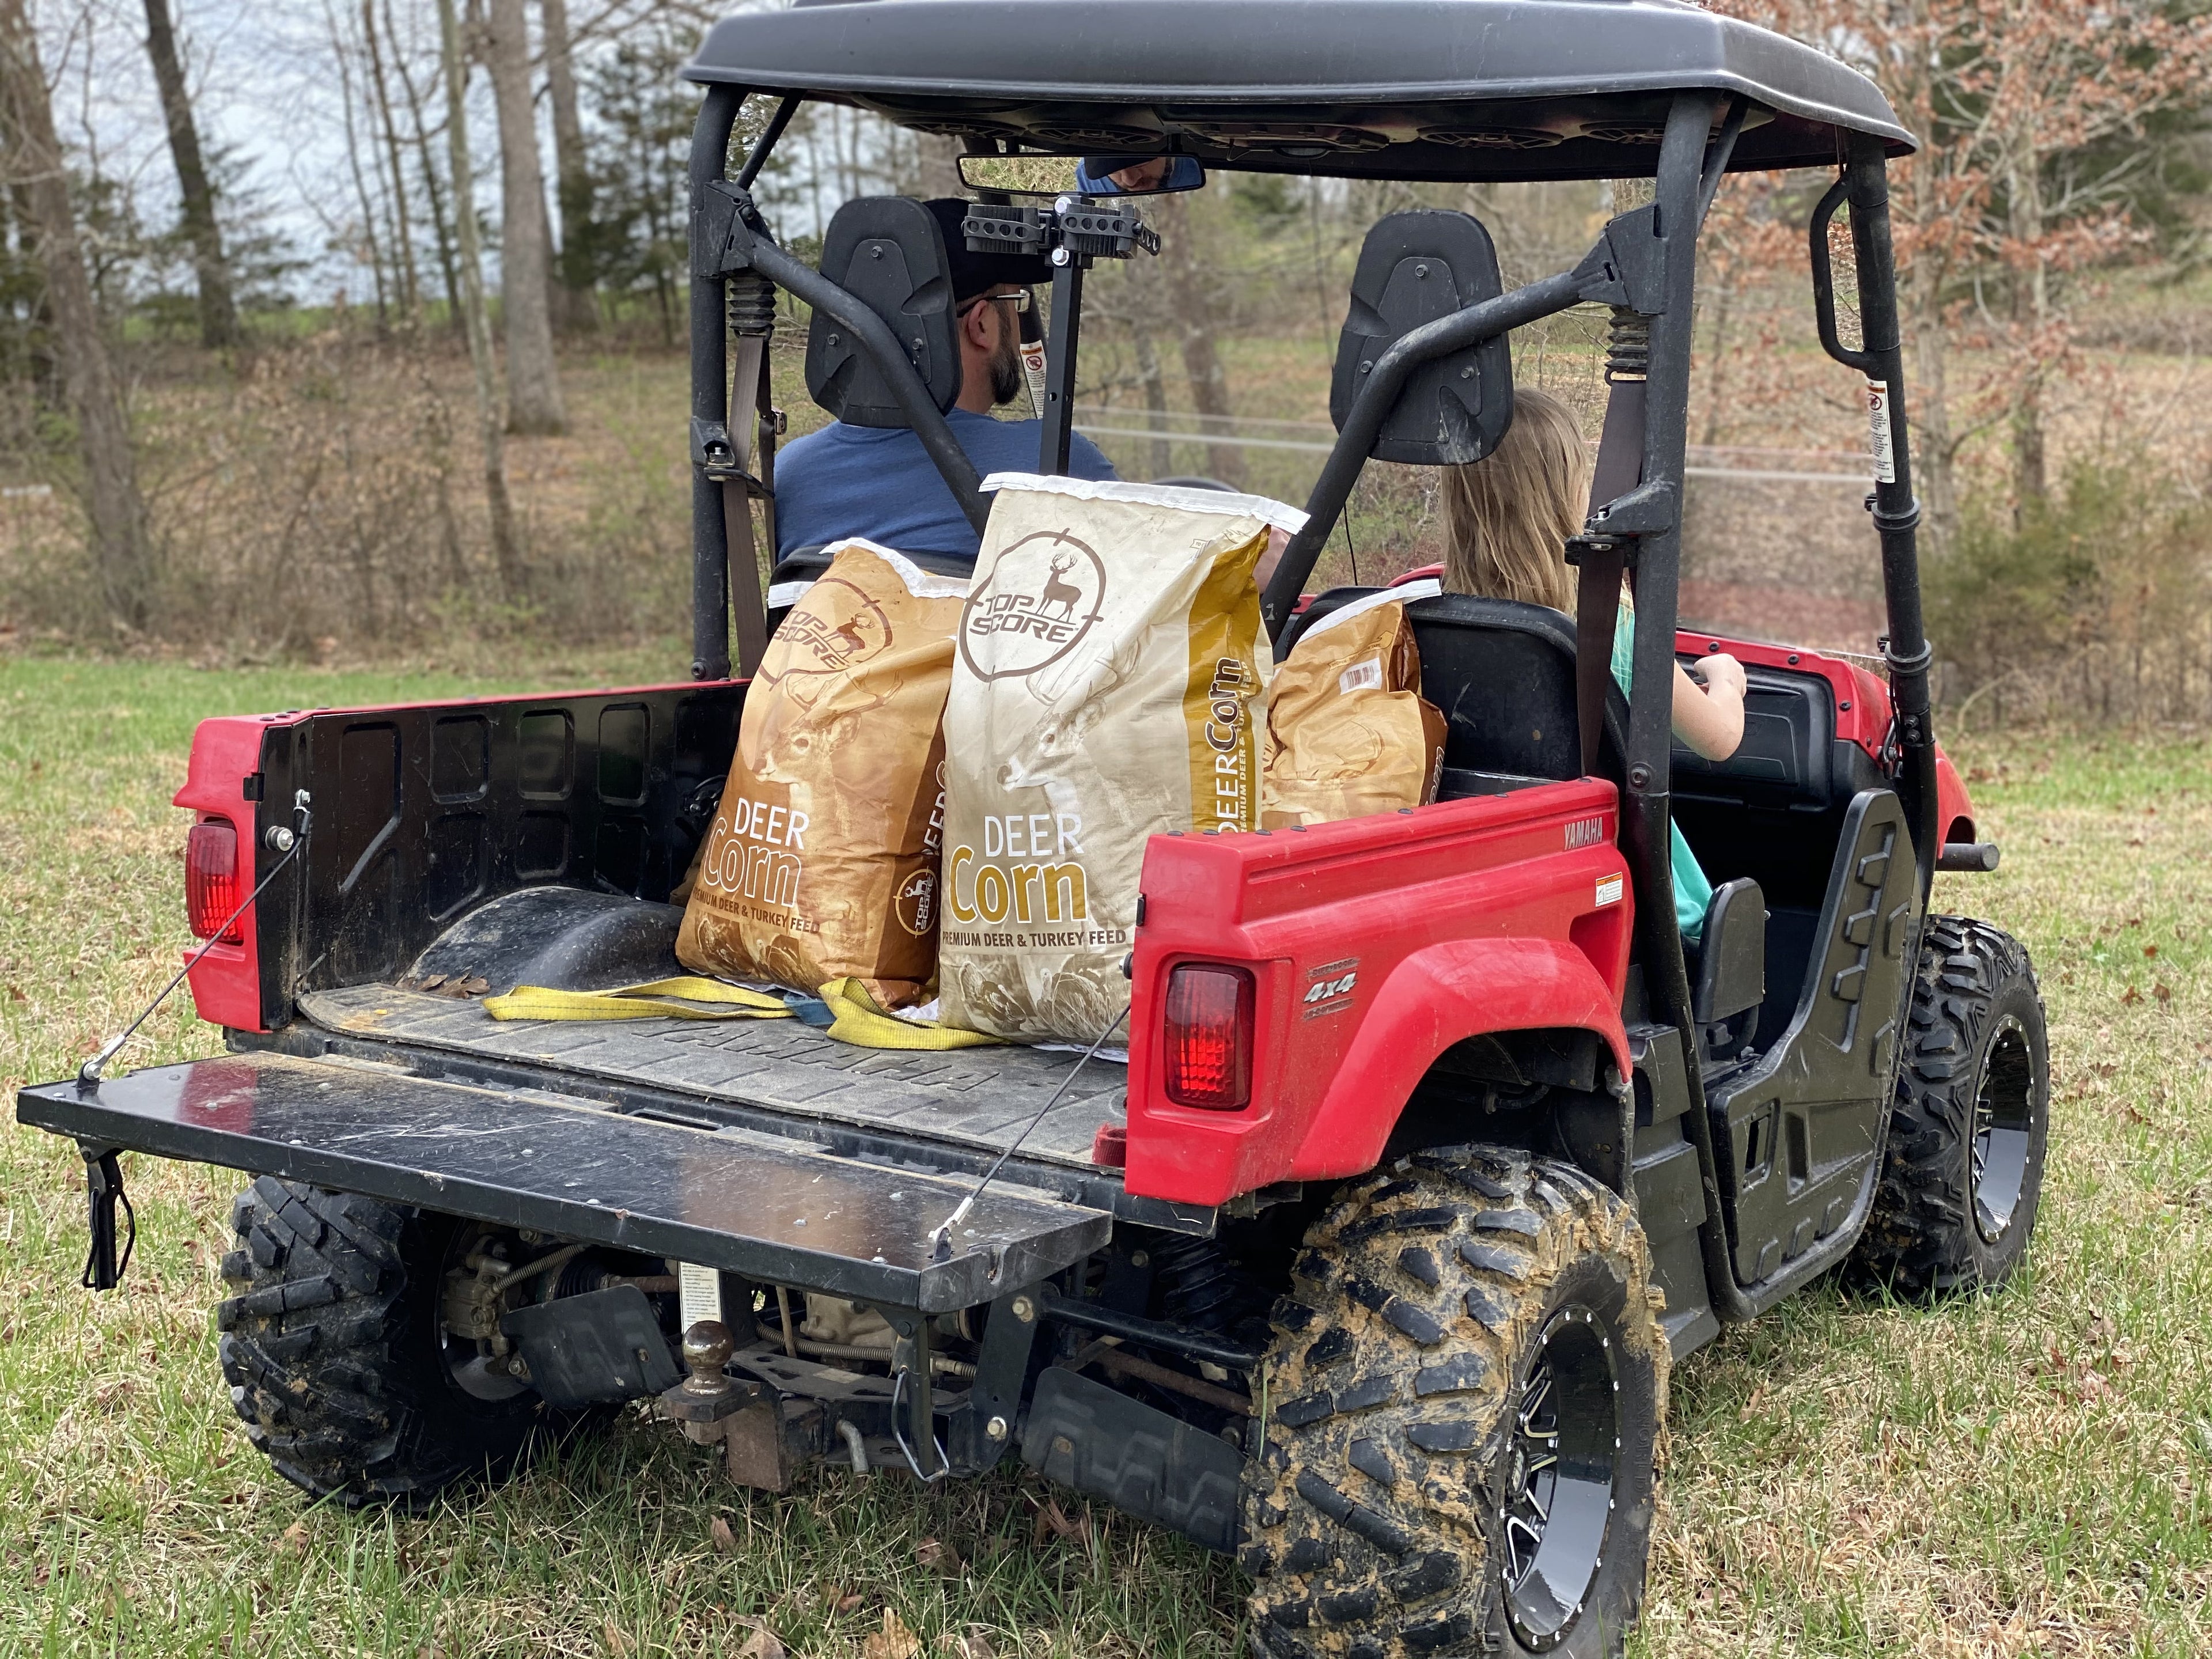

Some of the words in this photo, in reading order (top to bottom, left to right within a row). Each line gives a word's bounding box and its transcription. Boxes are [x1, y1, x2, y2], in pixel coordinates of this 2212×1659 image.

[783, 610, 828, 631] TOP
[986, 594, 1035, 615] TOP
[773, 626, 846, 669] SCORE
[969, 614, 1074, 643] SCORE
[1205, 657, 1242, 752] Corn
[1238, 737, 1245, 746] &
[1215, 754, 1238, 833] DEER
[1425, 746, 1445, 806] orn
[733, 797, 809, 849] DEER
[1240, 784, 1248, 833] EMIUM
[984, 813, 1084, 857] DEER
[1565, 817, 1603, 850] YAMAHA
[703, 817, 801, 907] Corn
[921, 874, 933, 930] SCORE
[949, 844, 1089, 925] Corn
[718, 897, 739, 915] DEER
[741, 904, 748, 918] &
[750, 907, 789, 928] TURKEY
[790, 917, 820, 934] FEED
[915, 896, 924, 929] TOP
[942, 931, 981, 947] PREMIUM
[984, 933, 1014, 947] DEER
[1017, 933, 1027, 946] &
[1029, 931, 1085, 947] TURKEY
[1089, 929, 1126, 945] FEED
